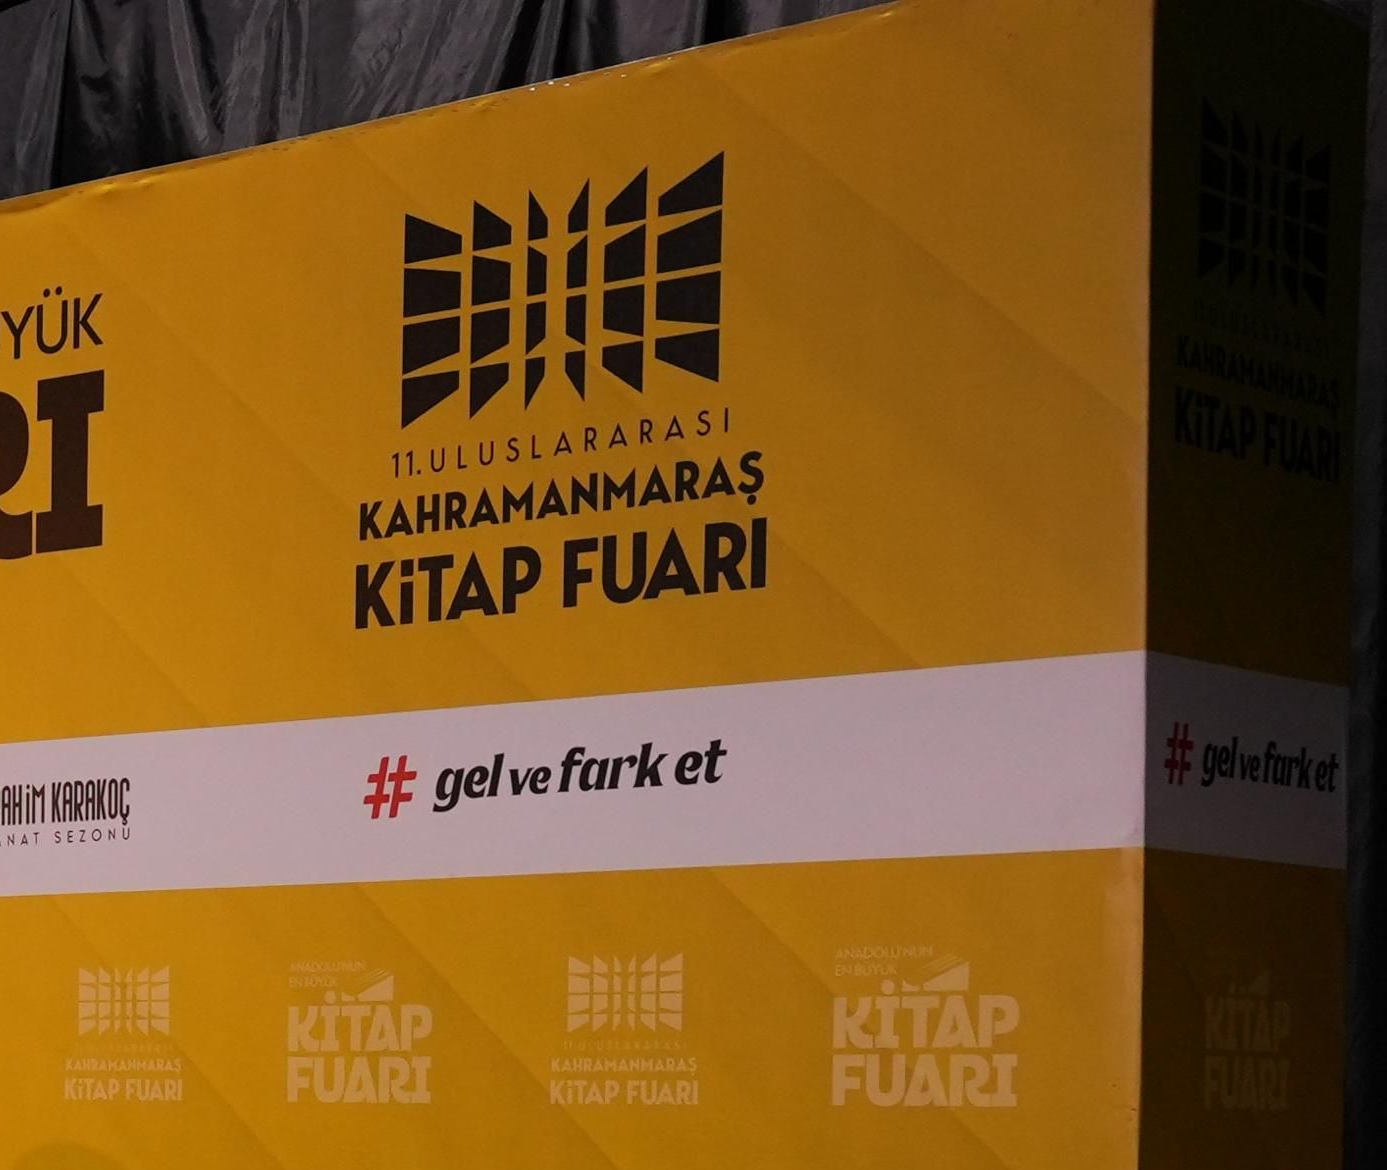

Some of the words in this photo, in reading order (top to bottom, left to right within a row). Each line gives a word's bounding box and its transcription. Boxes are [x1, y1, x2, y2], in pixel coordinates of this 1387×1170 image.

[391, 406, 730, 478] 11.ULUSLARARASI
[1265, 411, 1341, 483] FUARI
[358, 450, 765, 541] KAHRAMANMARAŞ
[563, 517, 768, 608] FUARI
[432, 753, 505, 813] gel
[509, 764, 552, 795] ve
[558, 742, 668, 794] fark
[673, 739, 728, 784] et
[1201, 737, 1237, 786] gel
[1239, 751, 1260, 781] ve
[1263, 742, 1311, 790] fark
[1315, 752, 1339, 792] et
[51, 777, 130, 826] KARAKOÇ
[54, 828, 131, 844] SEZONU
[287, 1055, 432, 1104] FUARI
[831, 1054, 1018, 1107] FUARI
